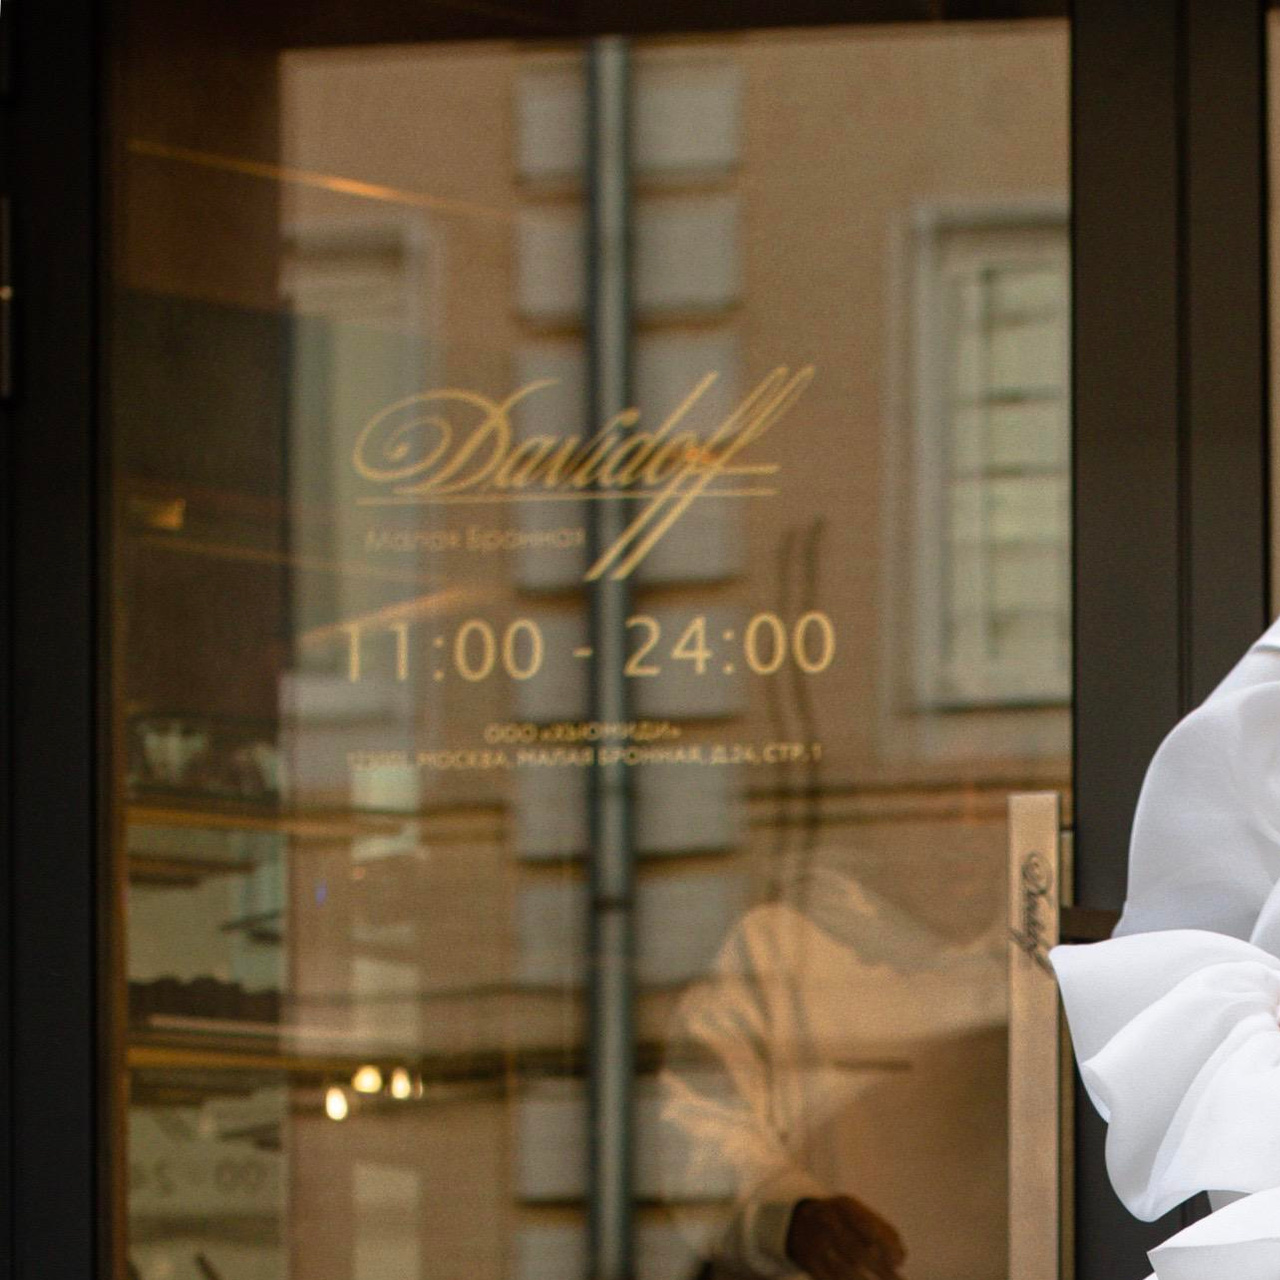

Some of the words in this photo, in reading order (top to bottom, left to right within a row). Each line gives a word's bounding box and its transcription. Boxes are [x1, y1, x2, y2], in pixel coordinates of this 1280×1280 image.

[352, 365, 816, 581] Davidoff
[341, 618, 544, 683] 11:00
[624, 610, 836, 677] 24:00
[483, 722, 538, 744] ООО
